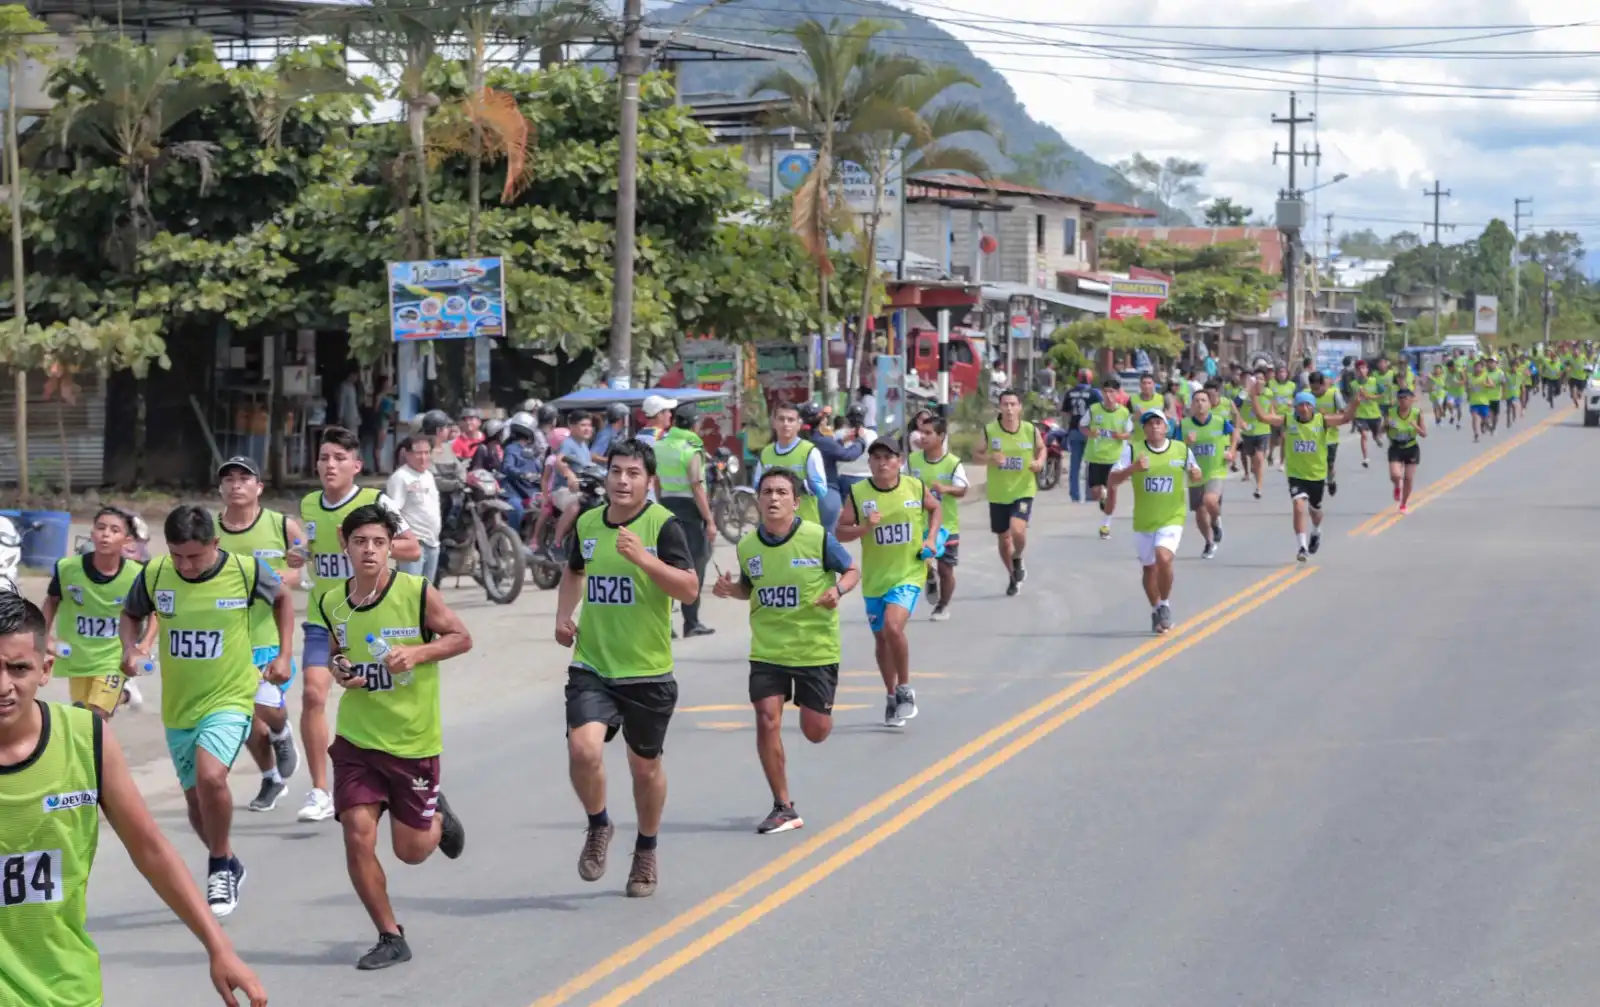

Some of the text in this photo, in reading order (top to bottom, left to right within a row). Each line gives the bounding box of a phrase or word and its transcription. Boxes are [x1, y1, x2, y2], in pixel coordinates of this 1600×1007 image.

[1145, 477, 1172, 492] 0577
[874, 524, 911, 545] 0391
[314, 553, 350, 577] 0581
[588, 576, 633, 603] 0526
[170, 631, 220, 658] 0557
[3, 851, 55, 905] 84
